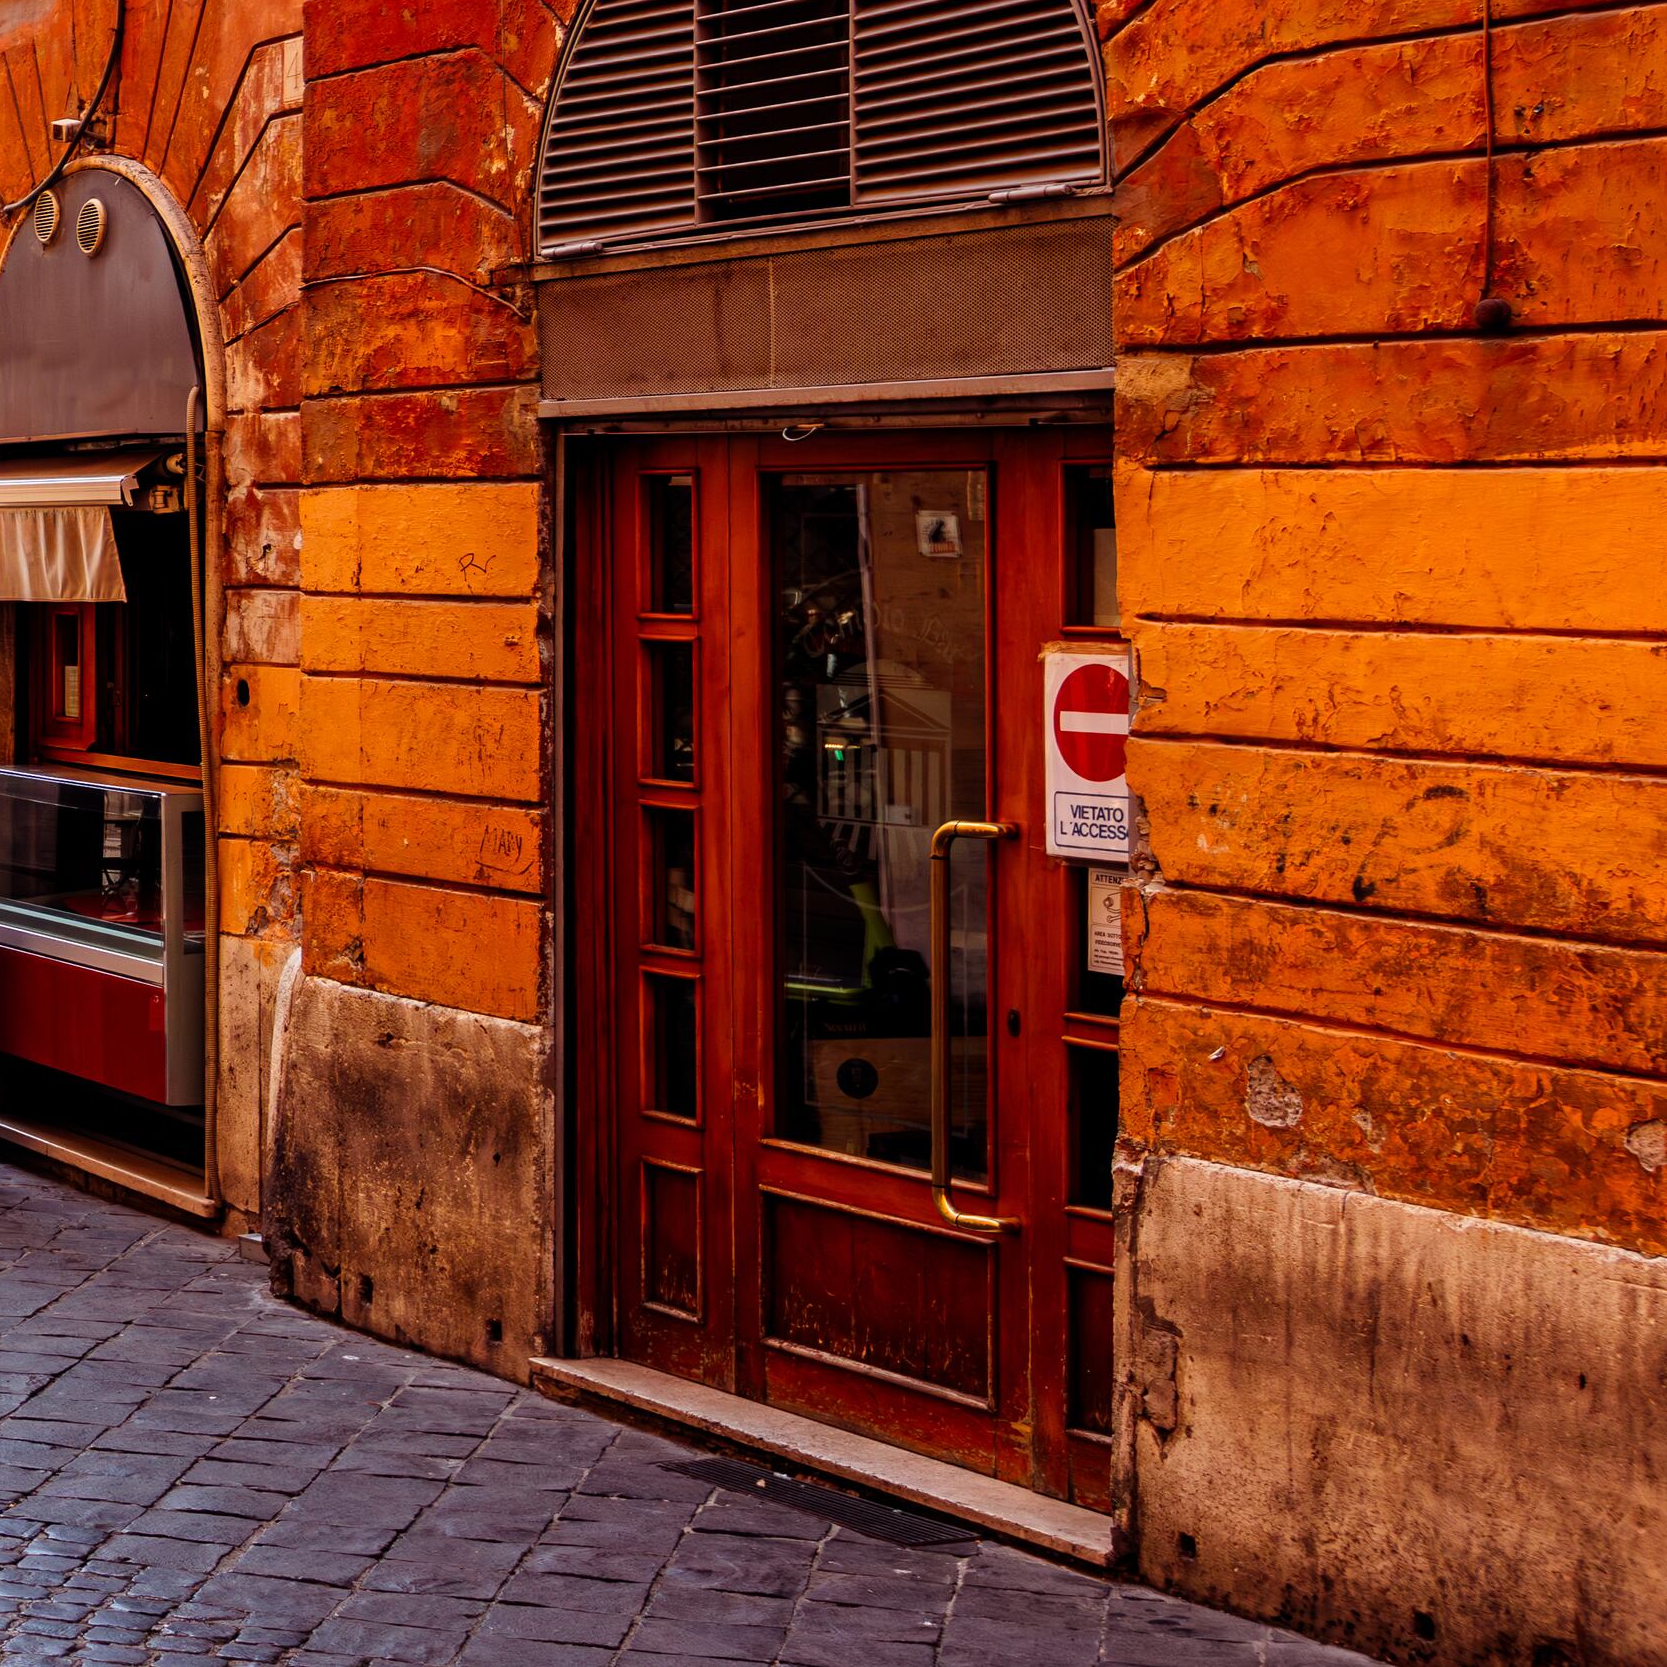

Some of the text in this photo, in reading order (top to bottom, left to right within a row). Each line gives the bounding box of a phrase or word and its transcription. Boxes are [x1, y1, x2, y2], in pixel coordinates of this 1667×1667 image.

[1070, 804, 1124, 823] VIETATO
[1060, 821, 1129, 841] L'ACCESS
[1095, 874, 1123, 885] ATTENZ
